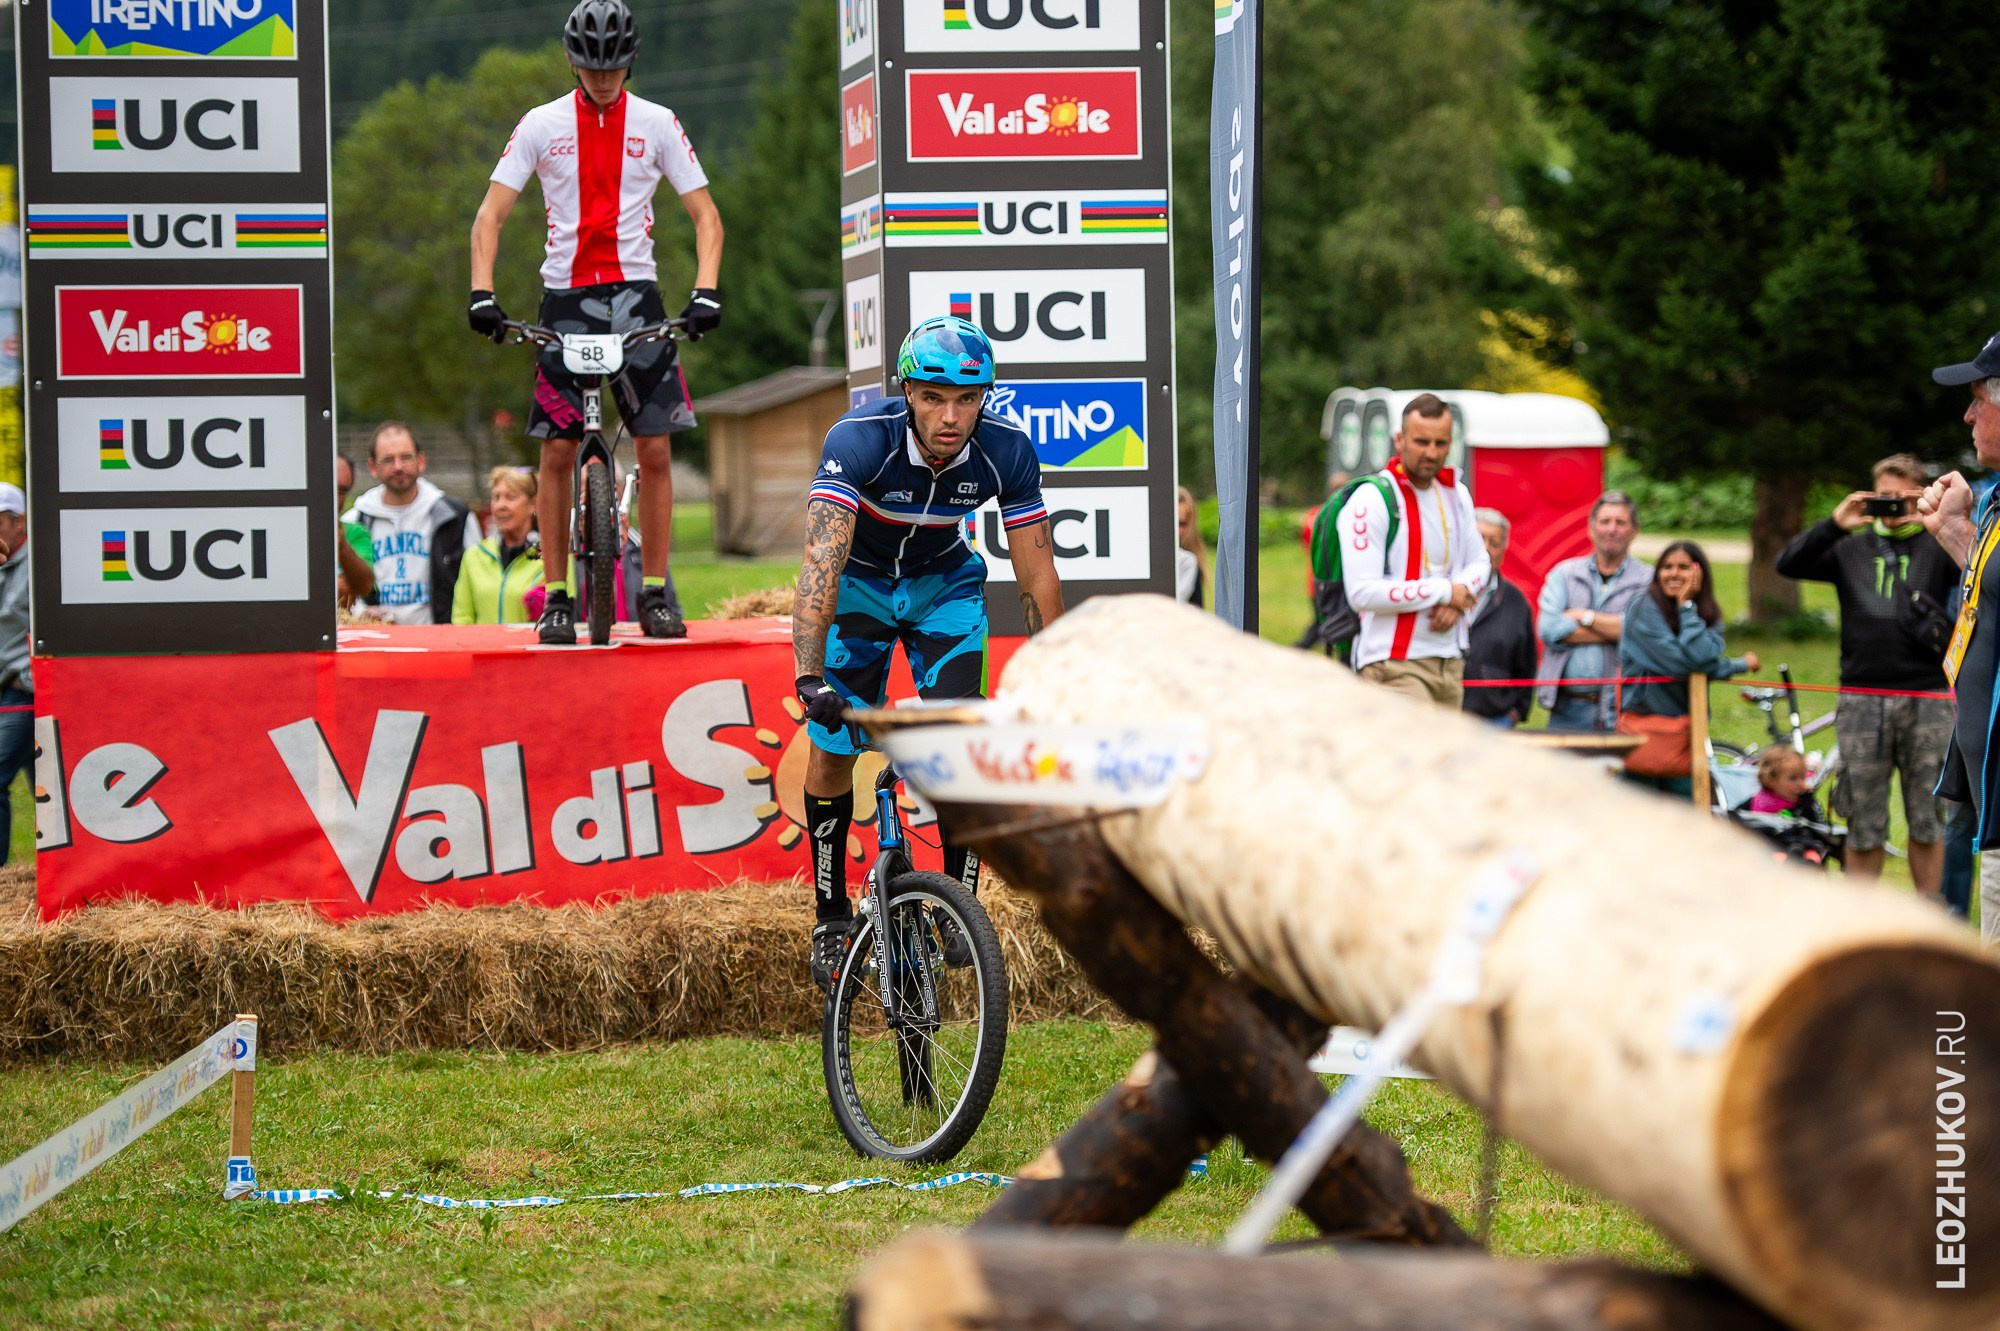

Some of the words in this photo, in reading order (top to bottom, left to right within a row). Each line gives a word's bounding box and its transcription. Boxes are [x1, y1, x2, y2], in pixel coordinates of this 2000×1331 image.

[973, 0, 1100, 30] UCI
[124, 99, 258, 150] UCI
[937, 92, 995, 138] Val
[998, 109, 1024, 135] di
[133, 214, 222, 248] UCI
[984, 201, 1067, 235] UCI
[89, 309, 149, 355] Val
[153, 326, 181, 352] di
[980, 292, 1106, 341] UCI
[131, 418, 265, 469] UCI
[1000, 400, 1115, 445] NTINO
[949, 497, 979, 506] LOOK
[134, 529, 267, 581] UCI
[984, 509, 1110, 559] UCI
[1389, 583, 1430, 602] CCC
[268, 709, 535, 904] Val
[551, 760, 664, 866] di
